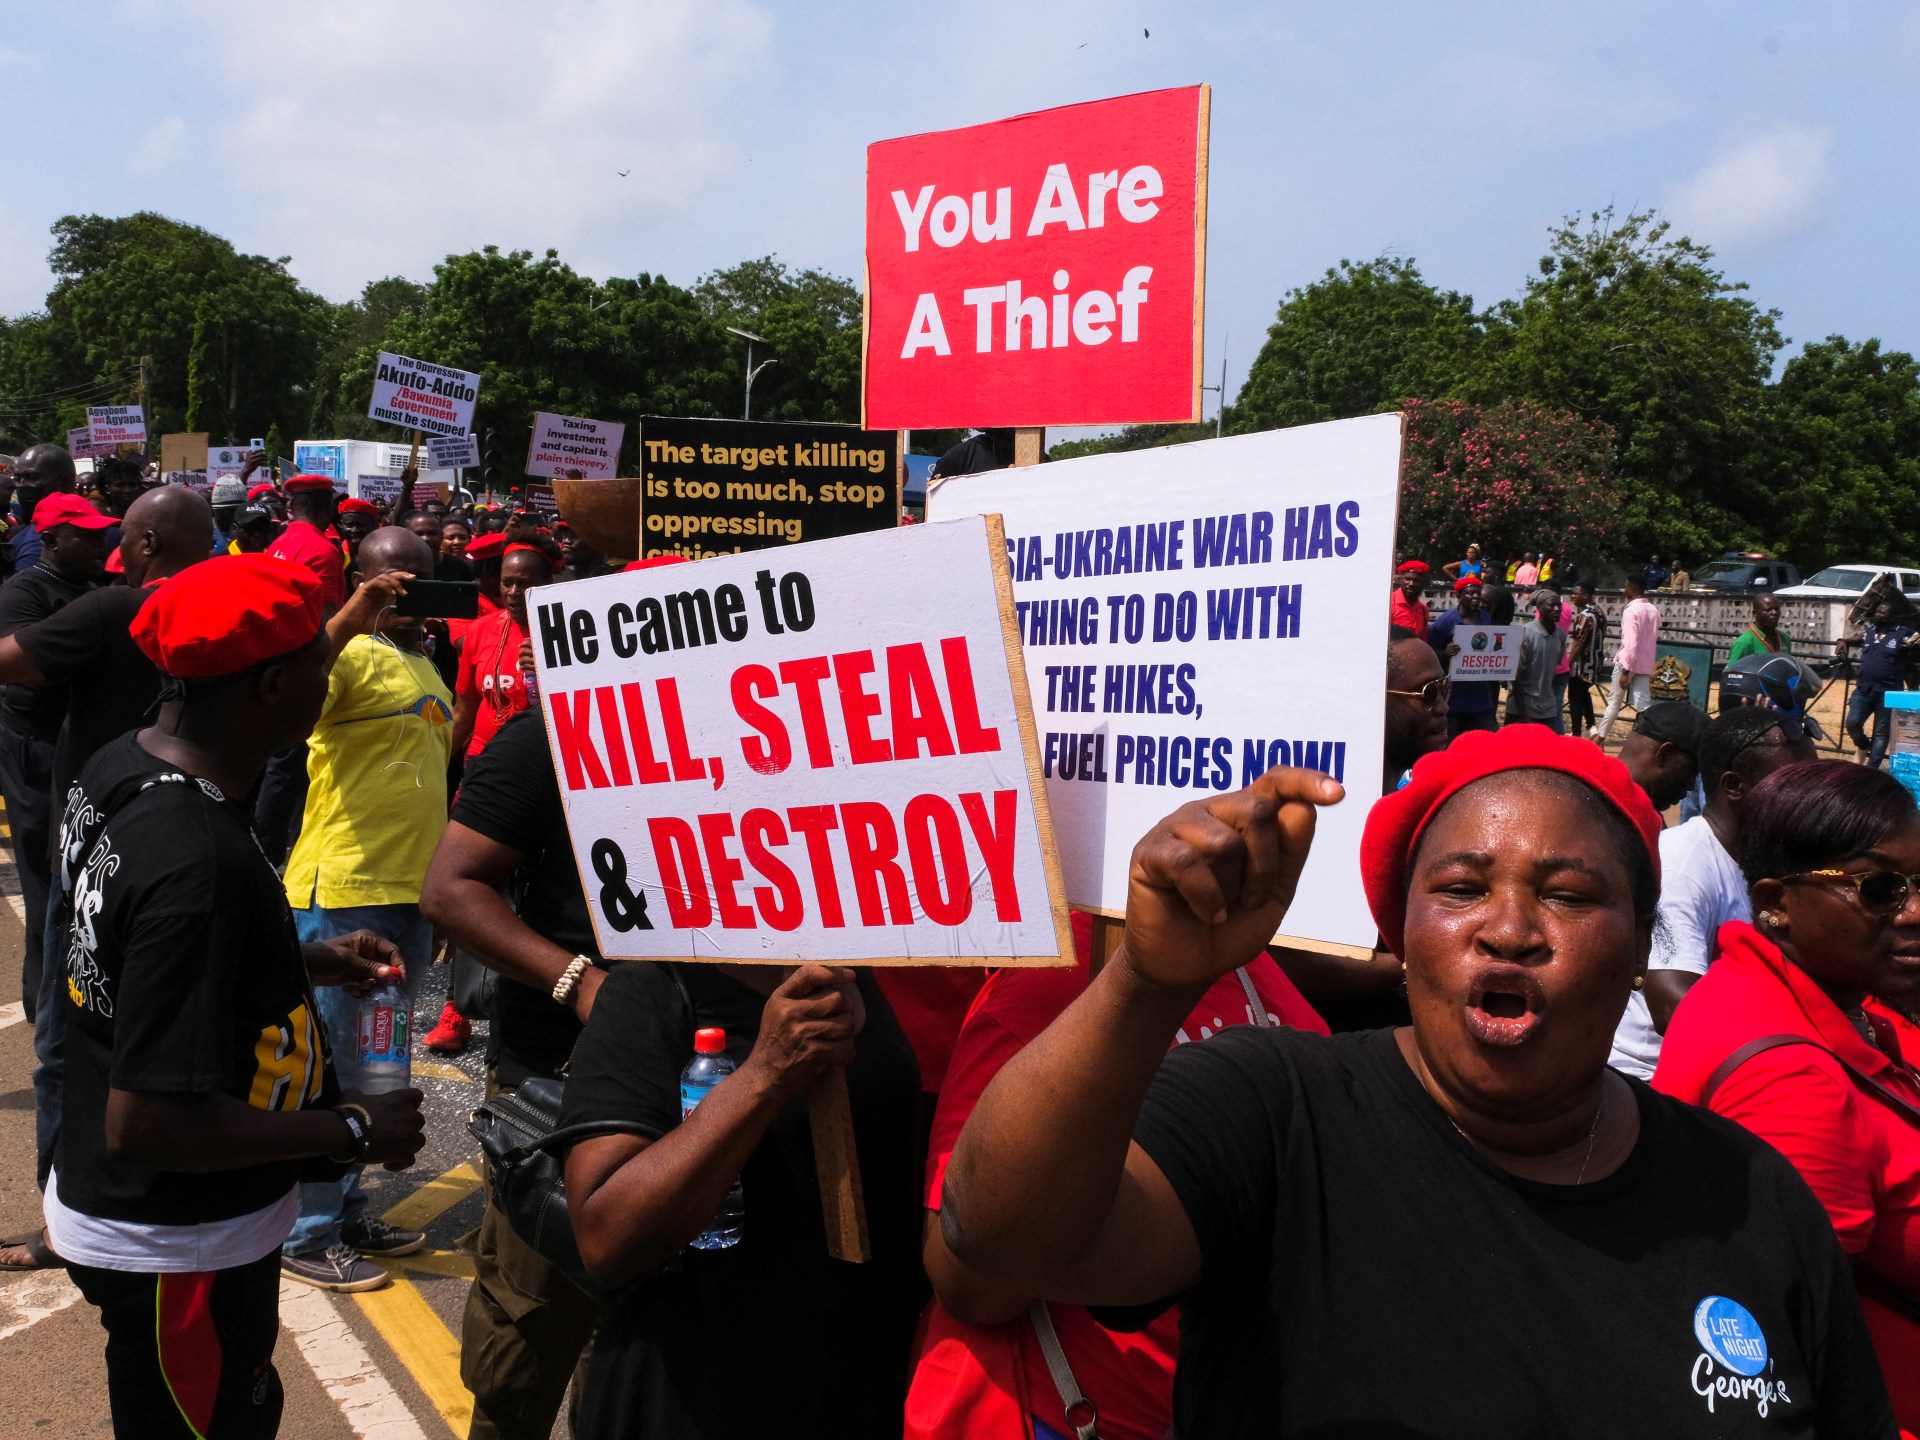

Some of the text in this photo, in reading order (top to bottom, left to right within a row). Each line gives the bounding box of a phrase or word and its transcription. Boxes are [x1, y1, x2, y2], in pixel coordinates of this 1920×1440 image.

[891, 163, 1164, 253] You Are
[900, 265, 1154, 359] A Thief
[377, 363, 475, 402] Akufo-Addo
[398, 356, 466, 381] The Oppressive
[374, 406, 466, 437] must be stopped
[390, 396, 458, 422] Government
[547, 428, 606, 445] investment
[562, 418, 597, 433] Taxing
[536, 453, 608, 471] plain thievery.
[540, 441, 608, 458] and capital is
[644, 439, 886, 473] The target killing
[361, 484, 381, 492] Police
[646, 472, 886, 508] is too much, stop
[646, 511, 803, 542] oppressing
[1192, 511, 1274, 569] WAR
[1282, 500, 1360, 562] HAS
[536, 569, 816, 669] He came to
[1107, 594, 1144, 644] TO
[1153, 590, 1198, 643] DO
[1207, 584, 1303, 641] WITH
[1461, 655, 1509, 668] RESPECT
[1045, 663, 1203, 721] THE HIKES,
[549, 635, 1002, 792] KILL, STEAL
[1044, 732, 1108, 782] FUEL
[1115, 734, 1233, 791] PRICES
[590, 789, 1023, 933] & DESTROY
[1709, 1317, 1743, 1337] LATE
[1721, 1337, 1763, 1357] NIGHT
